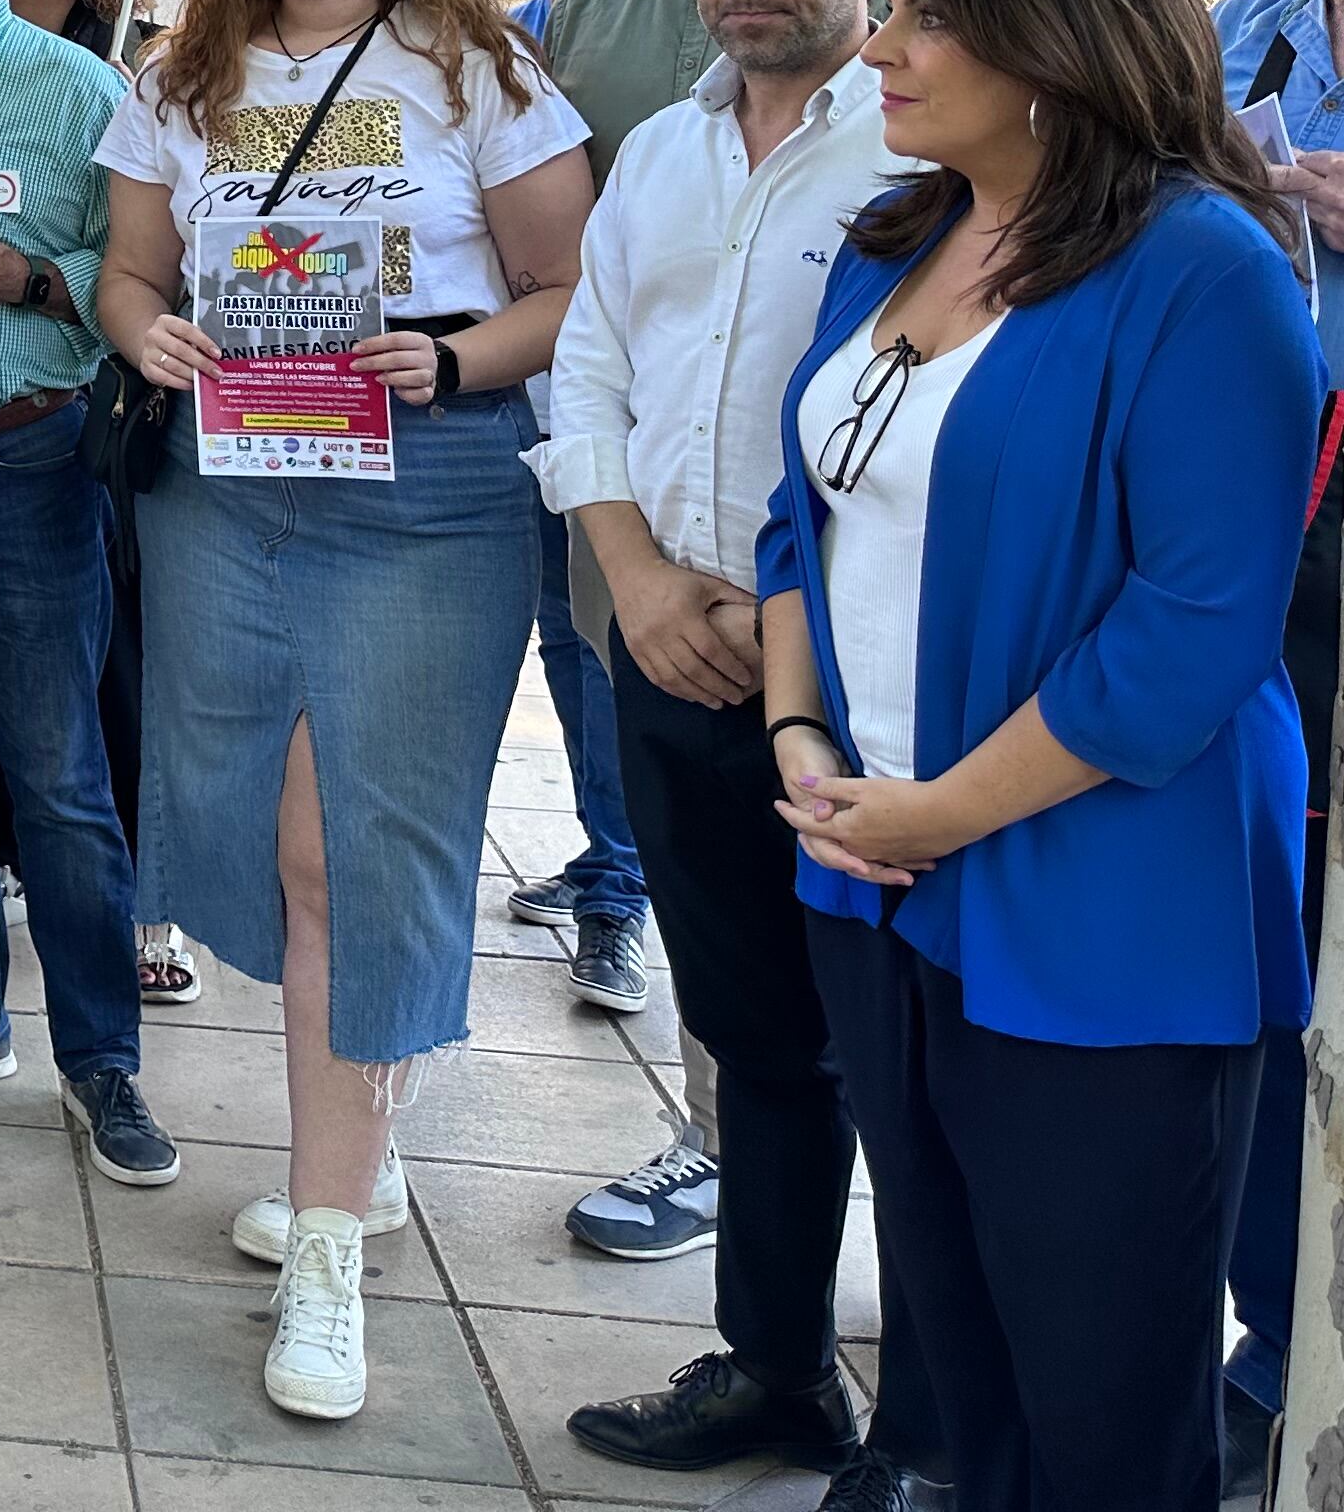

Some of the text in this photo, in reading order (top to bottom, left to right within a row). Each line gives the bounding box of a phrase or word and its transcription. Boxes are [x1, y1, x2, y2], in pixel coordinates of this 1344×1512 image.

[217, 296, 363, 313] ¡BASTA DE RETENER EL
[225, 313, 262, 329] BONO
[266, 314, 282, 328] DE
[282, 362, 294, 370] DE
[296, 363, 336, 371] OCTUBRE
